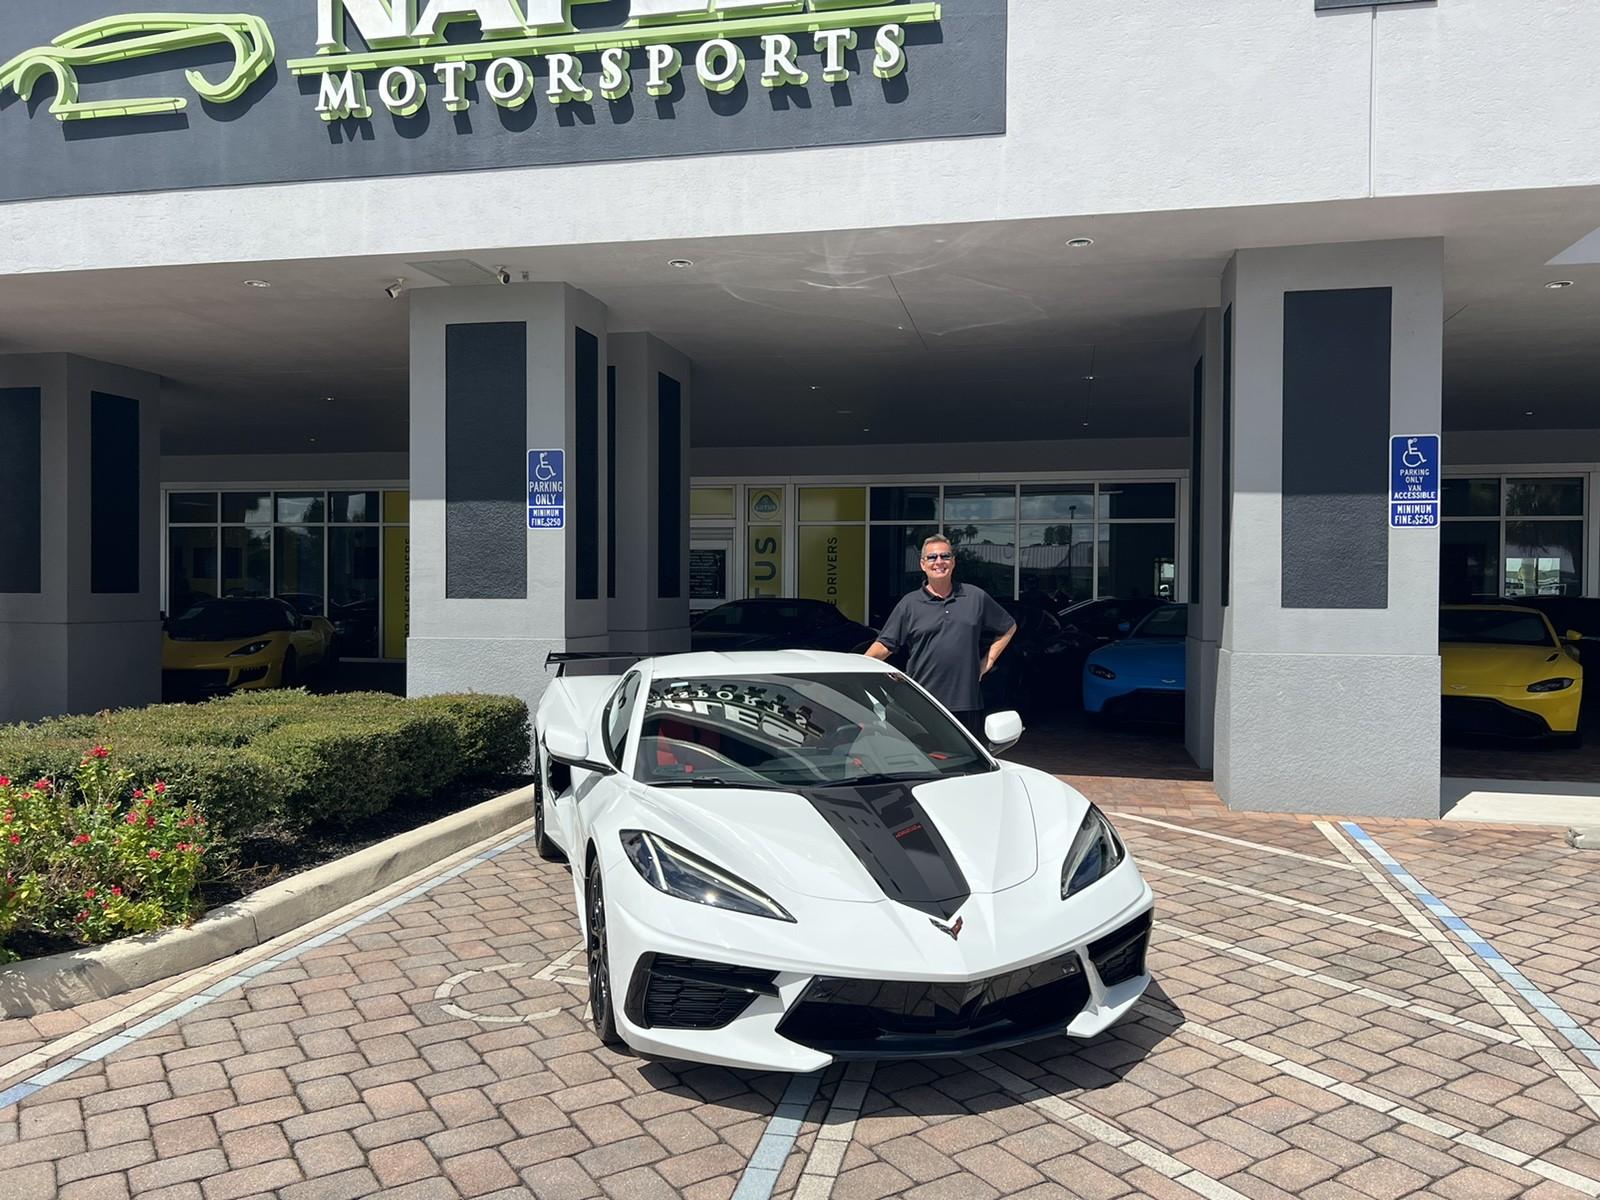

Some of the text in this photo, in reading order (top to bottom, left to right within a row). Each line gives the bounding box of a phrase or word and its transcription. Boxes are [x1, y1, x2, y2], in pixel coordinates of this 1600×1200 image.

[315, 23, 905, 114] MOTORSPORTS
[529, 481, 563, 492] PARKING
[535, 494, 557, 505] ONLY
[532, 509, 560, 517] MINIMUM
[1397, 504, 1432, 514] MINIMUM
[1394, 514, 1434, 525] FINE $250
[754, 537, 777, 598] TUS
[827, 536, 838, 595] DRIVERS
